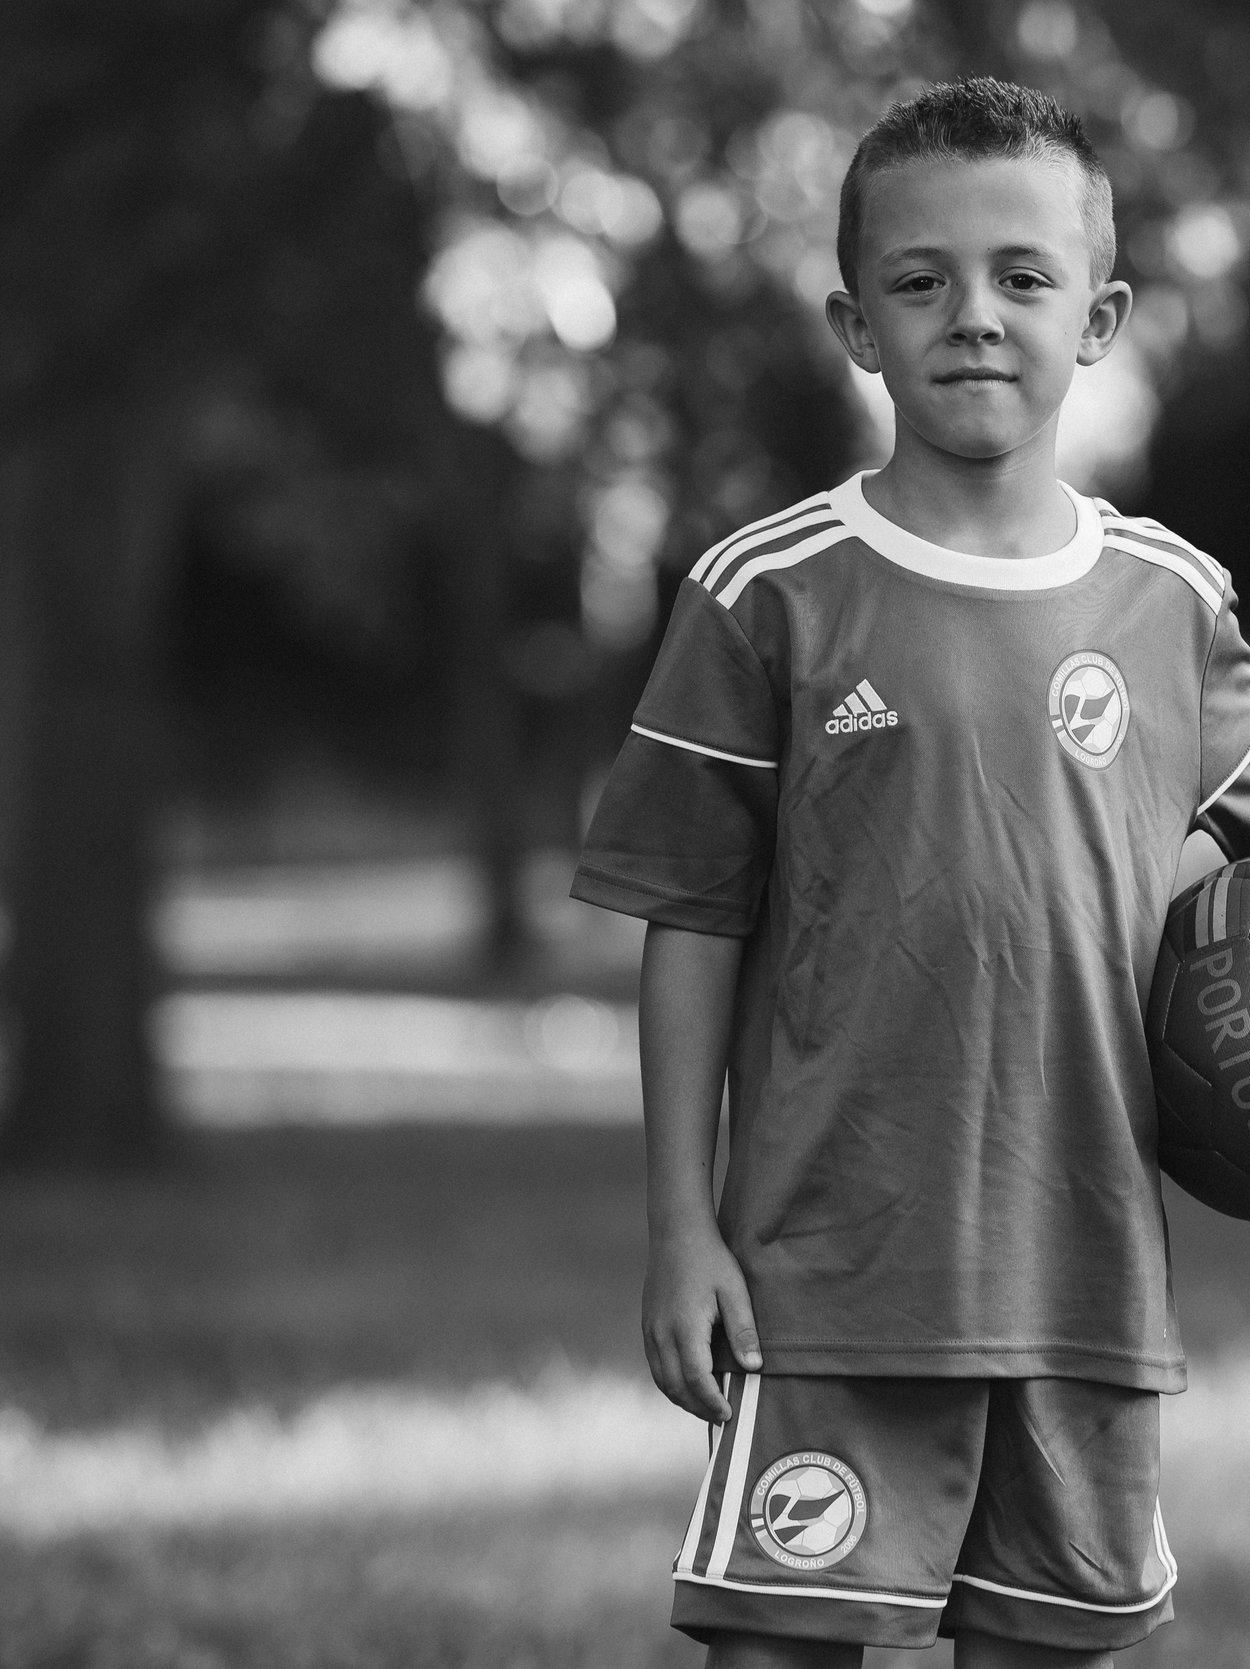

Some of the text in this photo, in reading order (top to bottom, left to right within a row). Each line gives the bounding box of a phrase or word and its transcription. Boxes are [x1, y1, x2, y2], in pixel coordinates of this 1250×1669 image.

[1052, 657, 1081, 697] COMILLAS
[1081, 654, 1104, 666] CLUB
[825, 711, 899, 735] adidas
[757, 1454, 866, 1515] COMILLAS CLUB DE FÚTBOL
[774, 1550, 825, 1568] LOGROÑO
